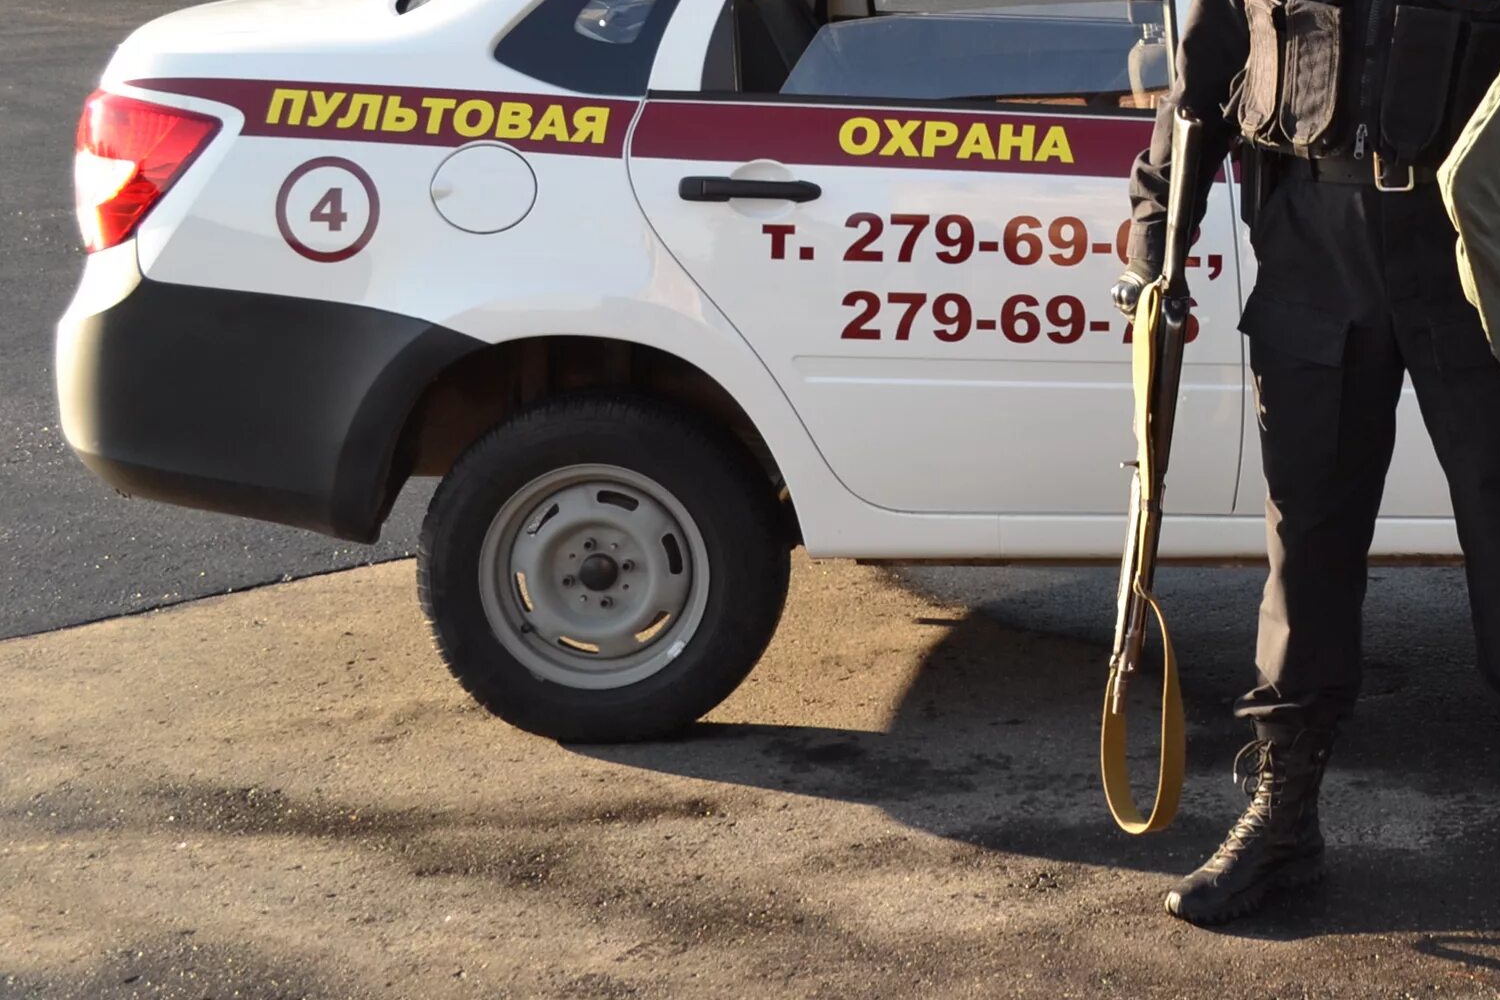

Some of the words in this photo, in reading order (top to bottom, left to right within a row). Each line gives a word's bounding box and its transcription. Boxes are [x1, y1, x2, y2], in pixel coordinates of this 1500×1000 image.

[266, 88, 610, 144] ПУЛЬТОВАЯ
[838, 116, 1075, 164] ОХРАНА
[309, 187, 348, 232] 4
[762, 224, 815, 260] т.
[843, 212, 1223, 281] 279-69-,
[840, 290, 1200, 345] 279-69-
